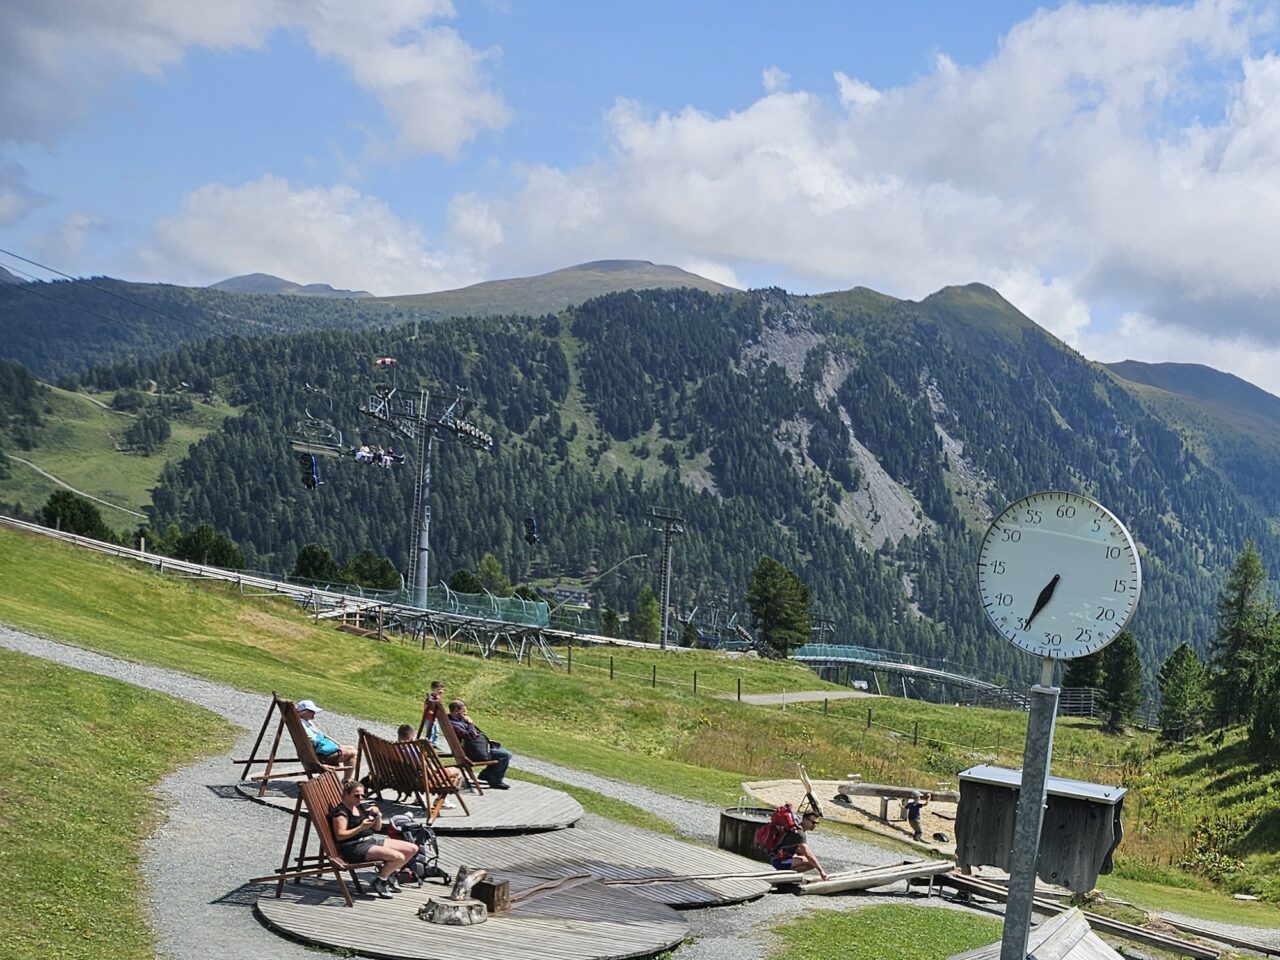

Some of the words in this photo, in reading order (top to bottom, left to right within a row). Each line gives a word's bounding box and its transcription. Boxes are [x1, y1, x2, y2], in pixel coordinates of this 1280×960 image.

[1025, 510, 1042, 524] 55
[1056, 505, 1075, 518] 60
[1092, 520, 1101, 532] 5
[1001, 529, 1021, 542] 50
[1105, 547, 1120, 559] 10
[990, 560, 1006, 575] 45
[1113, 580, 1126, 593] 15
[995, 594, 1013, 606] 40
[1096, 607, 1115, 620] 20
[1014, 617, 1031, 631] 35
[1041, 632, 1061, 646] 30
[1075, 628, 1092, 642] 25
